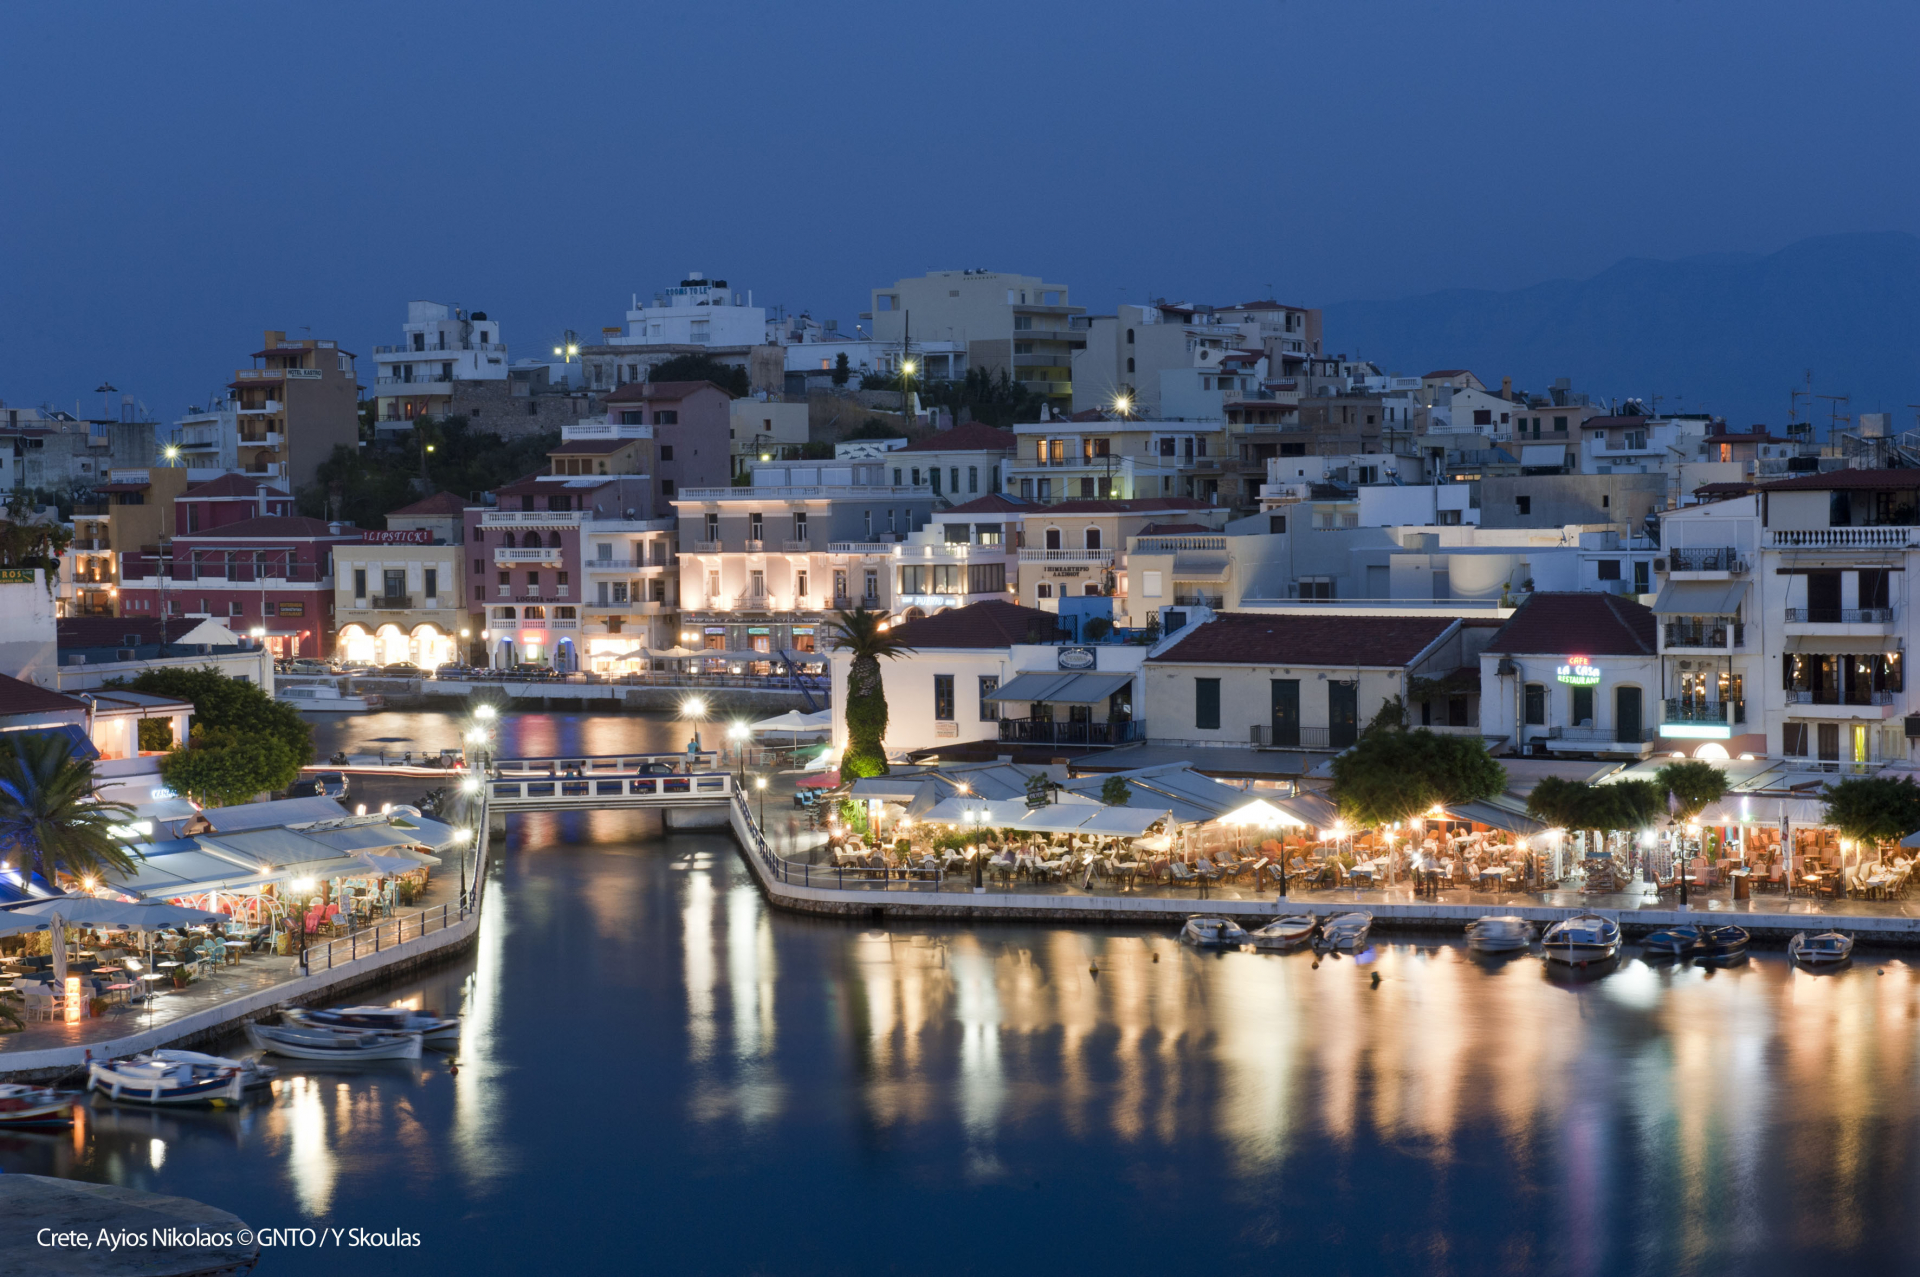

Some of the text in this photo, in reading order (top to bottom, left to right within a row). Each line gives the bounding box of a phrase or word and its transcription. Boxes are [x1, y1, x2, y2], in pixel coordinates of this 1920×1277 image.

[665, 288, 688, 296] ROOMS
[689, 287, 698, 295] TO
[368, 531, 424, 542] LIPSTICK
[0, 570, 22, 579] ROS
[1569, 656, 1589, 665] CAFE
[1557, 665, 1600, 677] LA CASA
[1557, 675, 1600, 685] RESTAURANT
